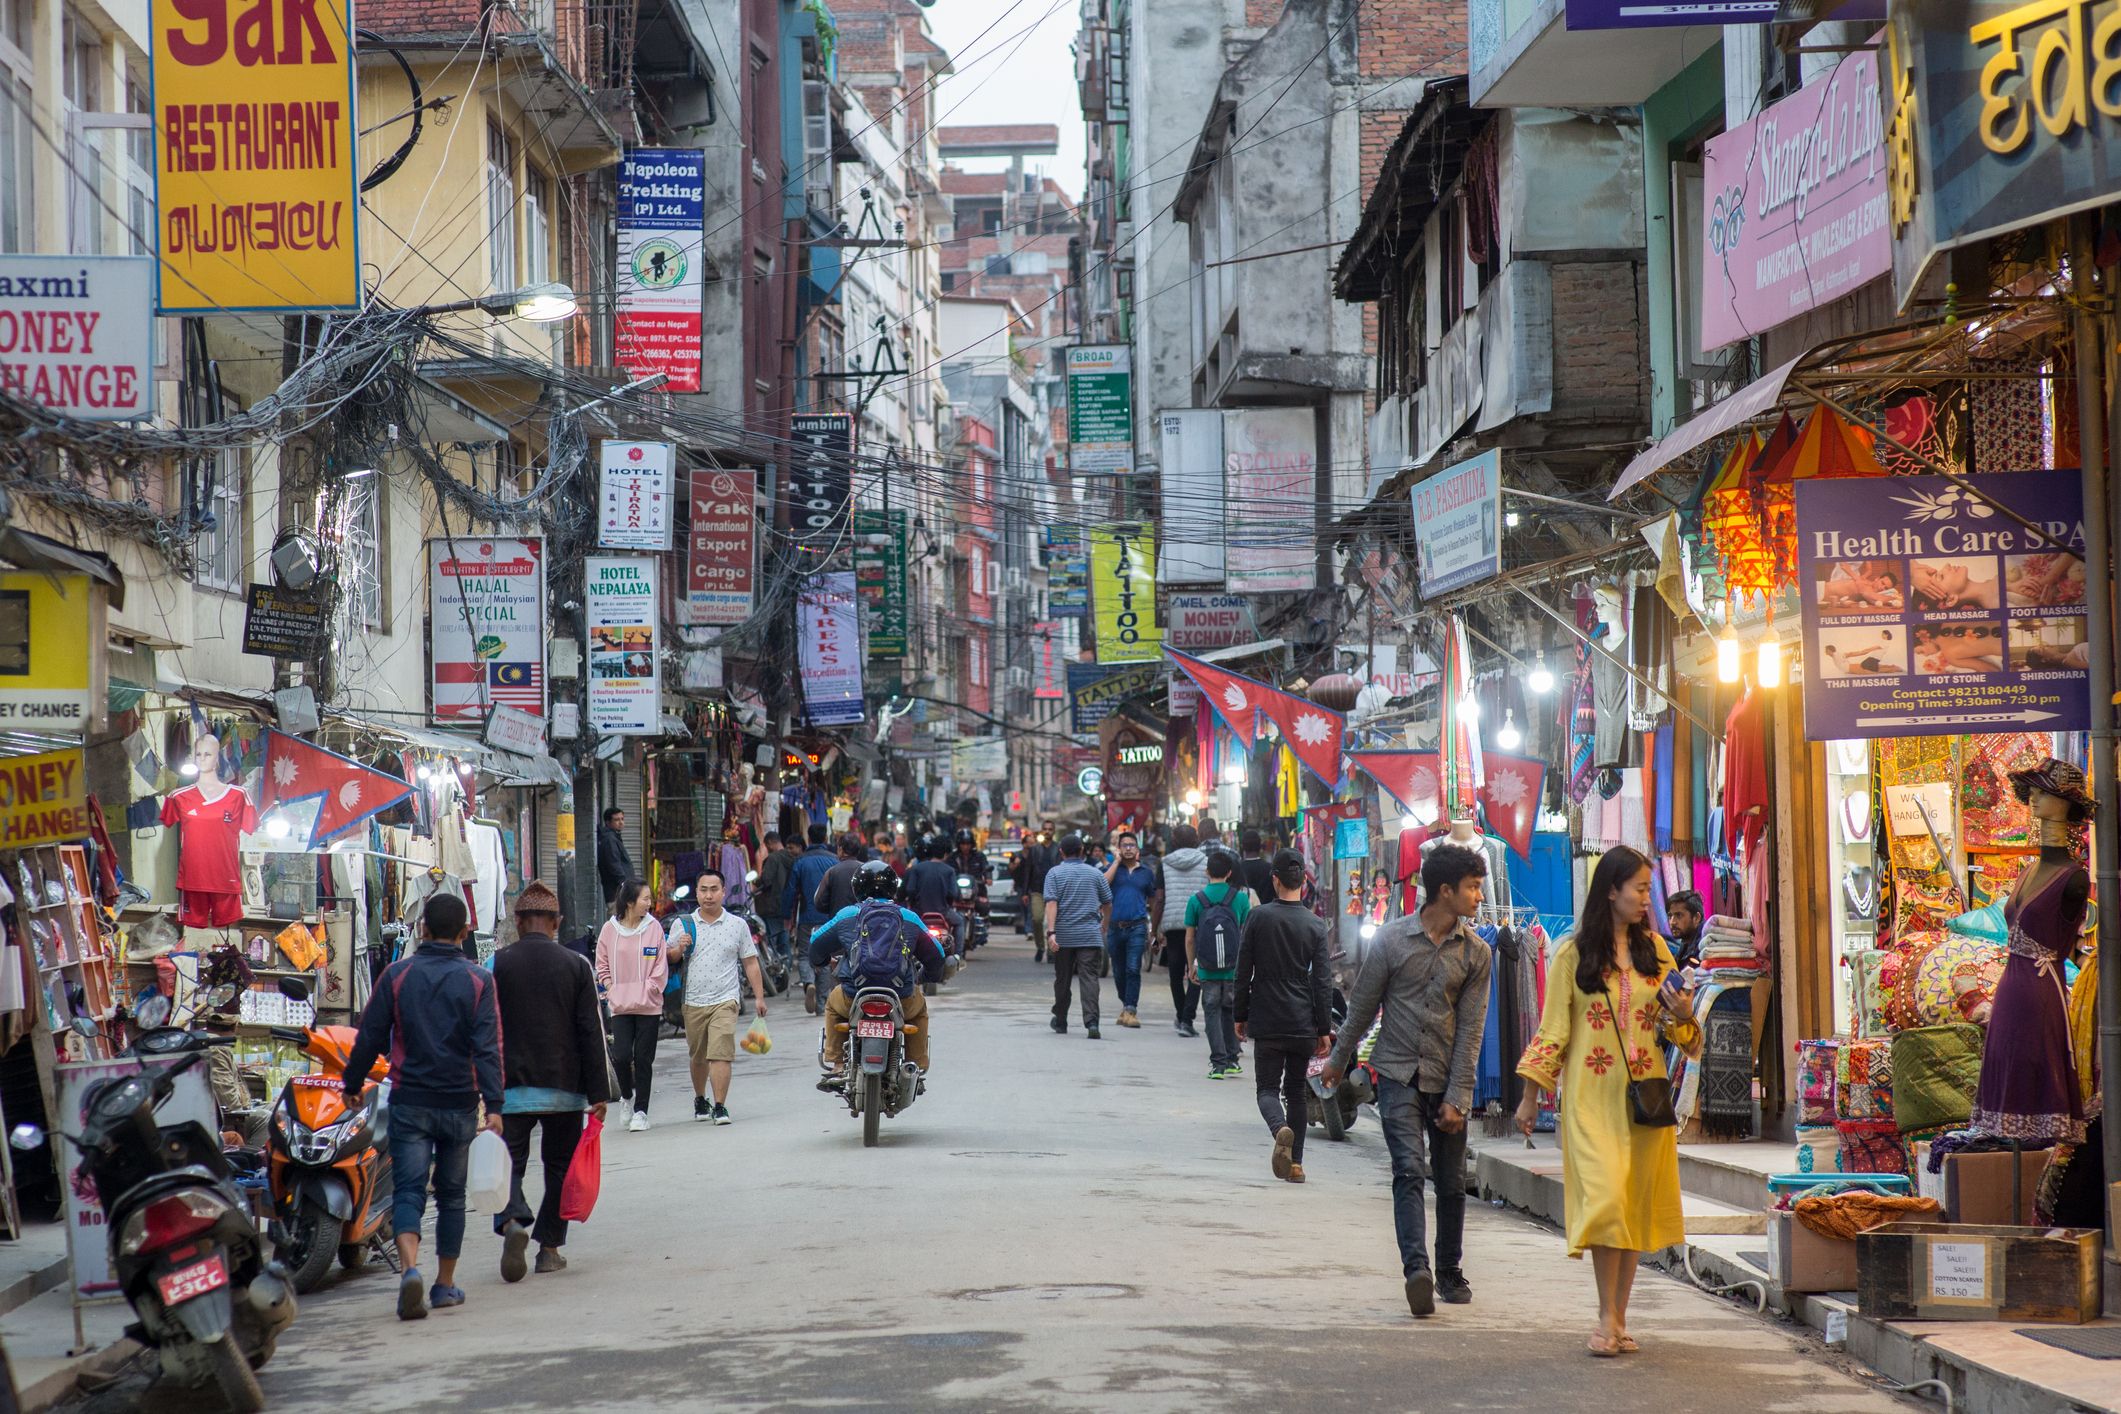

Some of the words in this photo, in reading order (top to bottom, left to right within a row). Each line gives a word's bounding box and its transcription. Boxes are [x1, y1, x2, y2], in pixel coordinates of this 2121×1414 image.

[166, 102, 340, 172] RESTAURANT
[1760, 85, 1848, 219] Shangri-La
[624, 162, 698, 180] Napoleon
[620, 183, 703, 202] Trekking
[635, 202, 653, 216] (P)
[658, 204, 687, 215] Ltd.
[1811, 209, 1856, 265] WHOLESALER
[668, 321, 689, 329] Nepal
[792, 417, 846, 430] Lumbini
[608, 468, 663, 476] HOTEL
[806, 434, 832, 527] TATTOO
[1434, 464, 1487, 516] PASHMINA
[628, 478, 641, 528] TRIRATNA
[696, 501, 750, 515] Yak
[694, 519, 749, 532] International
[696, 538, 746, 554] Export
[1814, 529, 1922, 558] Health
[1934, 526, 2014, 553] Care
[600, 567, 640, 580] HOTEL
[696, 564, 746, 581] Cargo
[464, 578, 511, 593] HALAL
[590, 582, 651, 595] NEPALAYA
[704, 582, 717, 590] (P)
[719, 582, 736, 590] Ltd.
[494, 595, 535, 605] Malaysian
[1180, 597, 1206, 608] WEL
[1211, 597, 1247, 608] COME
[1185, 611, 1239, 626] MONEY
[1950, 611, 1990, 619] MASSAGE
[2010, 608, 2037, 617] FOOT
[2039, 606, 2088, 615] MASSAGE
[1864, 615, 1901, 623] MASSAGE
[815, 605, 840, 665] TREKS
[1173, 630, 1251, 645] EXCHANGE
[1929, 676, 1949, 684] HOT
[1952, 675, 1986, 683] STONE
[2020, 671, 2087, 681] SHIRODHARA
[1826, 681, 1850, 689] THAI
[1852, 678, 1900, 687] MASSAGE
[1892, 688, 1945, 699] Contact:
[1948, 685, 2027, 697] 9823180449
[22, 703, 80, 718] CHANGE
[1860, 700, 1914, 712] Opening
[1917, 697, 1953, 709] Time:
[1955, 696, 2007, 707] 9:30am-
[2010, 695, 2039, 705] 7:30
[2041, 695, 2061, 706] pm
[1905, 715, 1936, 724] 3rd
[1947, 713, 2016, 722] Floor
[1120, 745, 1162, 763] TATTOO
[1900, 793, 1927, 802] WAL
[1951, 1288, 1968, 1297] 150
